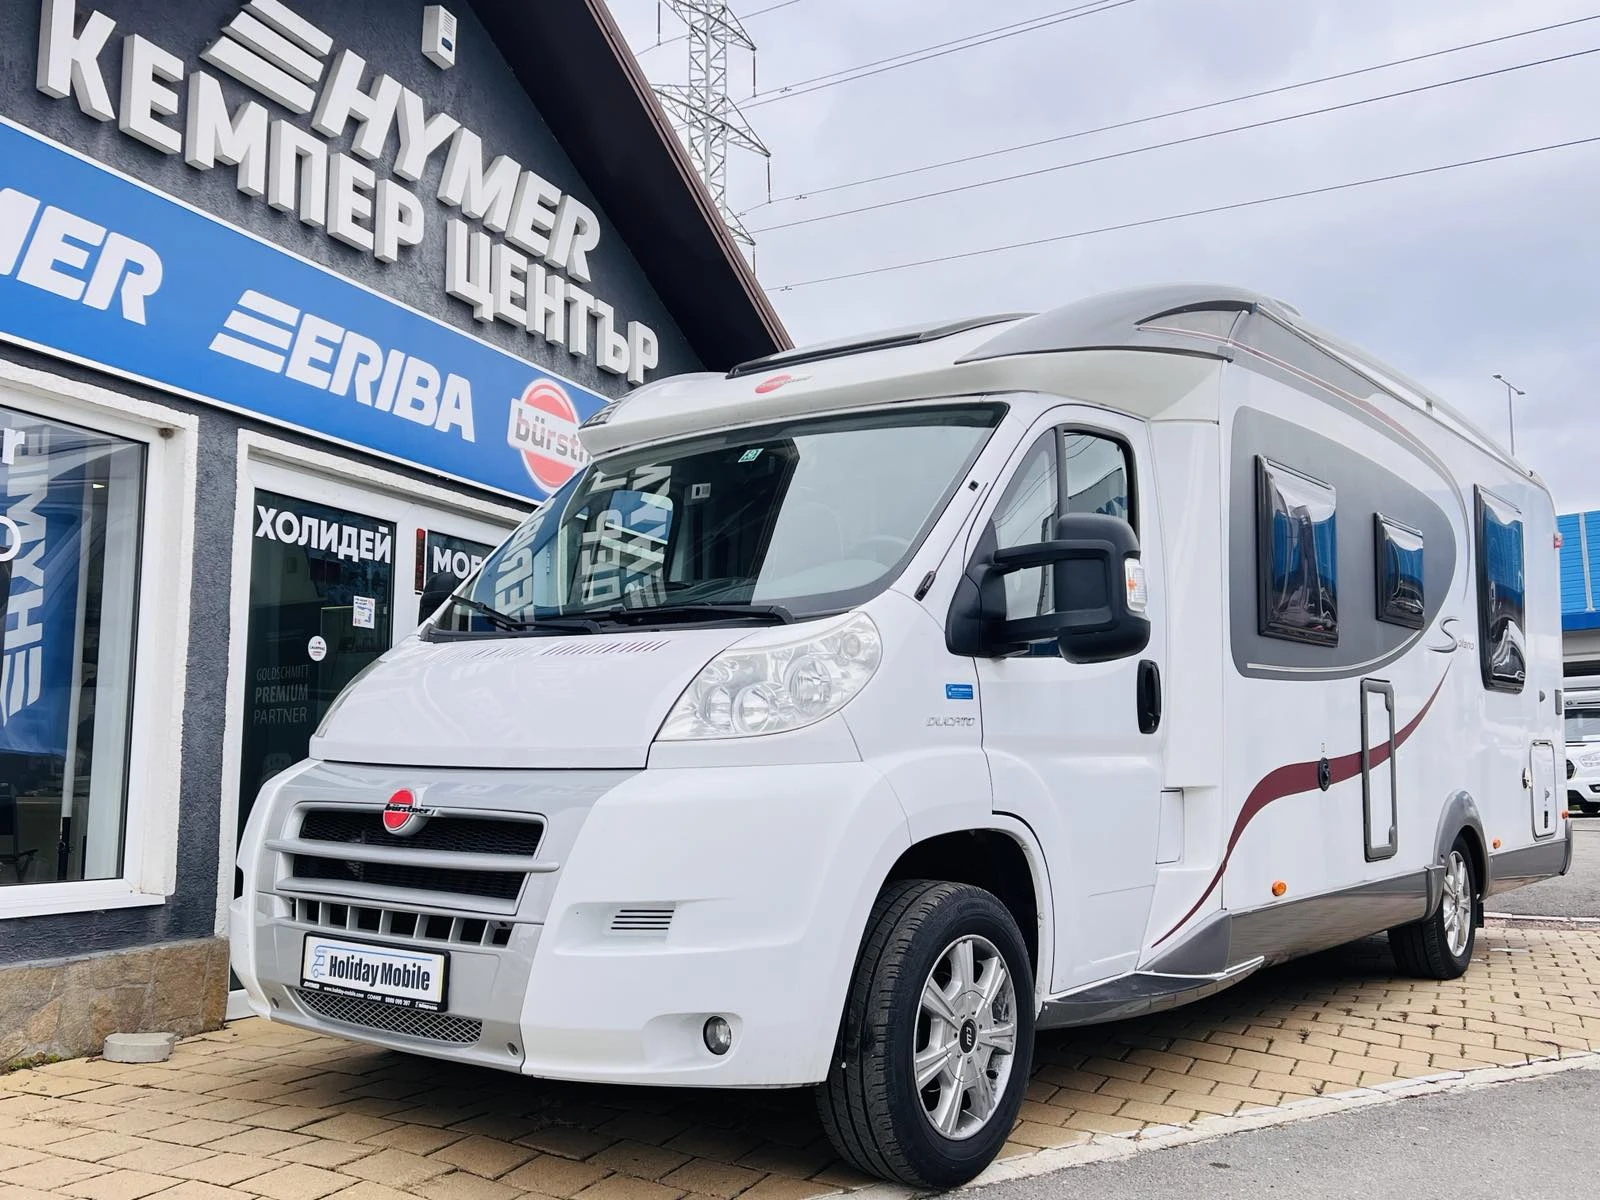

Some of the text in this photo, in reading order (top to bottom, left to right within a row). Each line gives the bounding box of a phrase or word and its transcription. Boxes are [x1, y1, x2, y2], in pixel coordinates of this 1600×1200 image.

[36, 0, 659, 386] КЕМПЕР ЦЕНТЪР
[310, 47, 601, 283] HYMER
[284, 312, 476, 444] ERIBA
[515, 407, 592, 463] bürst
[255, 504, 392, 564] ХОЛИДЕЙ
[255, 683, 309, 704] PREMIUM
[256, 664, 310, 681] GOLDSCHMITT
[253, 706, 308, 725] PARTNER
[328, 954, 431, 991] Holiday Mobile
